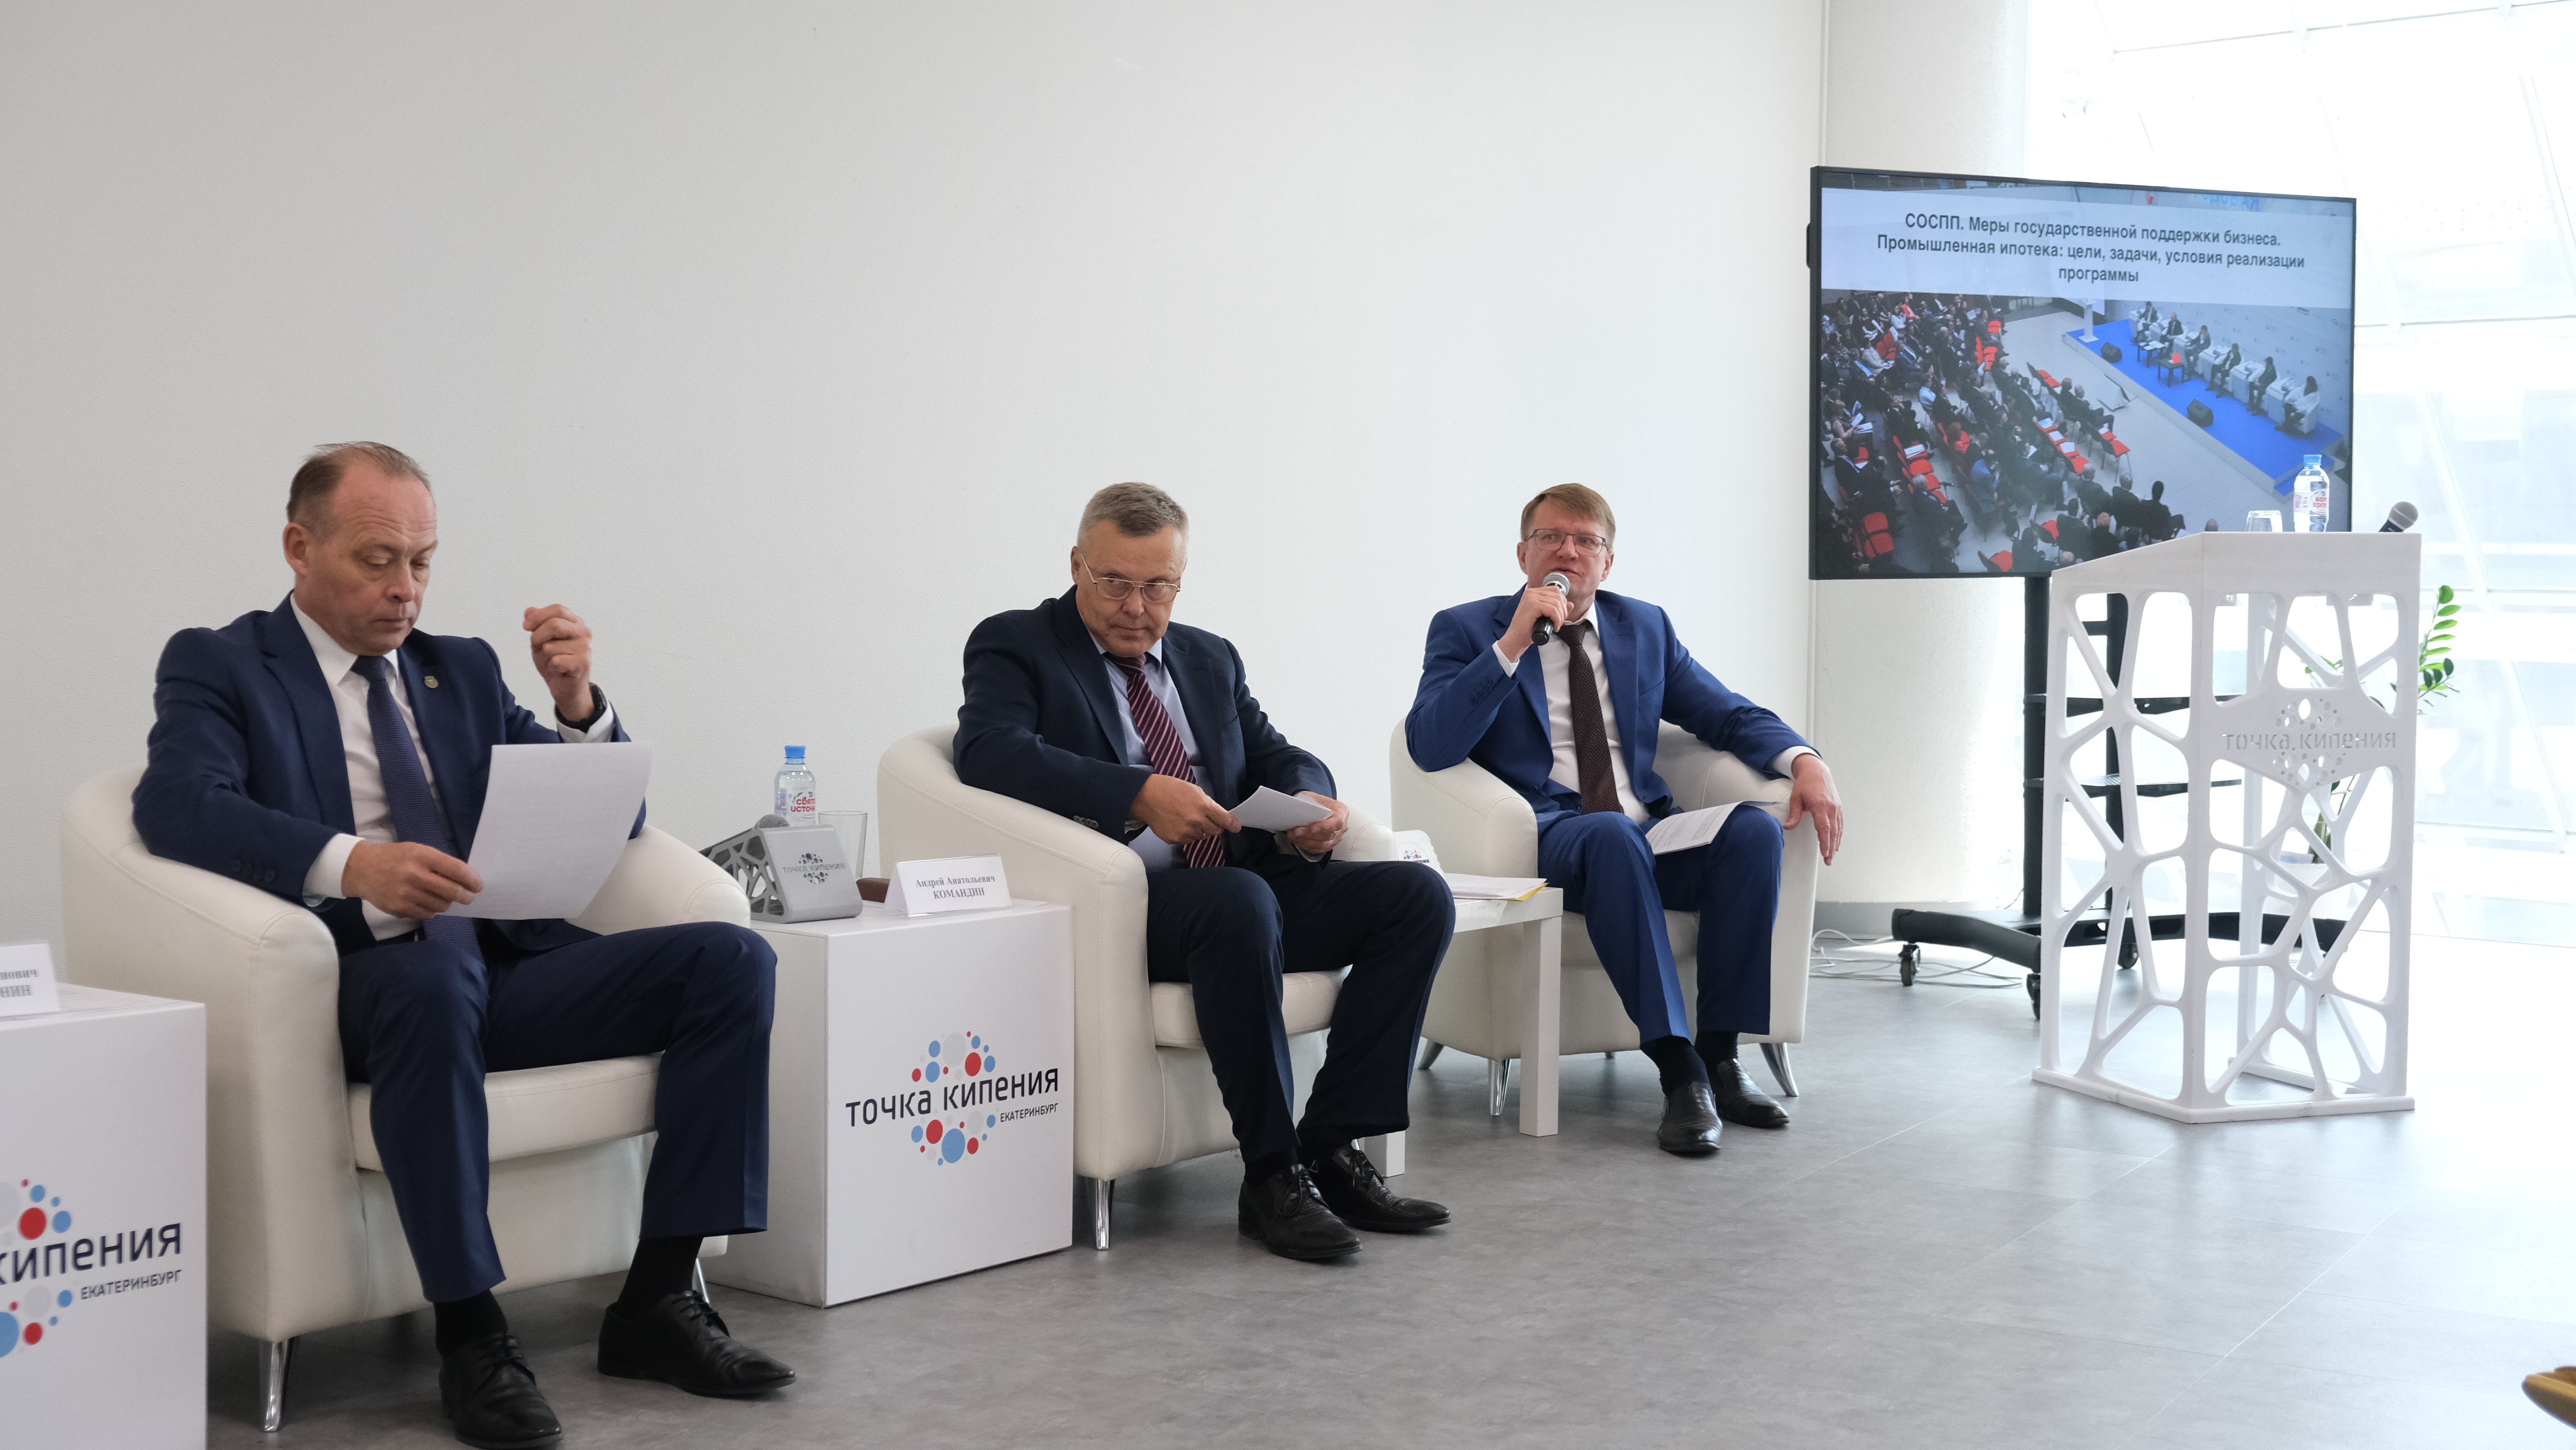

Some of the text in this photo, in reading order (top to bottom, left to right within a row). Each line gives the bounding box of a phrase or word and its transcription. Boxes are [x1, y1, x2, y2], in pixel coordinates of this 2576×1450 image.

[1906, 213, 2281, 246] СОСПП. Меры государственной поддержки бизнеса.
[1878, 234, 2305, 269] Промышленная ипотека: цели, задачи, условия реализации
[2059, 268, 2139, 283] программы
[916, 876, 996, 888] Андрей Анатольевич
[933, 887, 985, 899] КОМАНДИН
[1000, 1103, 1059, 1123] ЕКАТЕРИНБУРГ
[80, 1270, 182, 1300] ЕКАТЕРИНБУРГ
